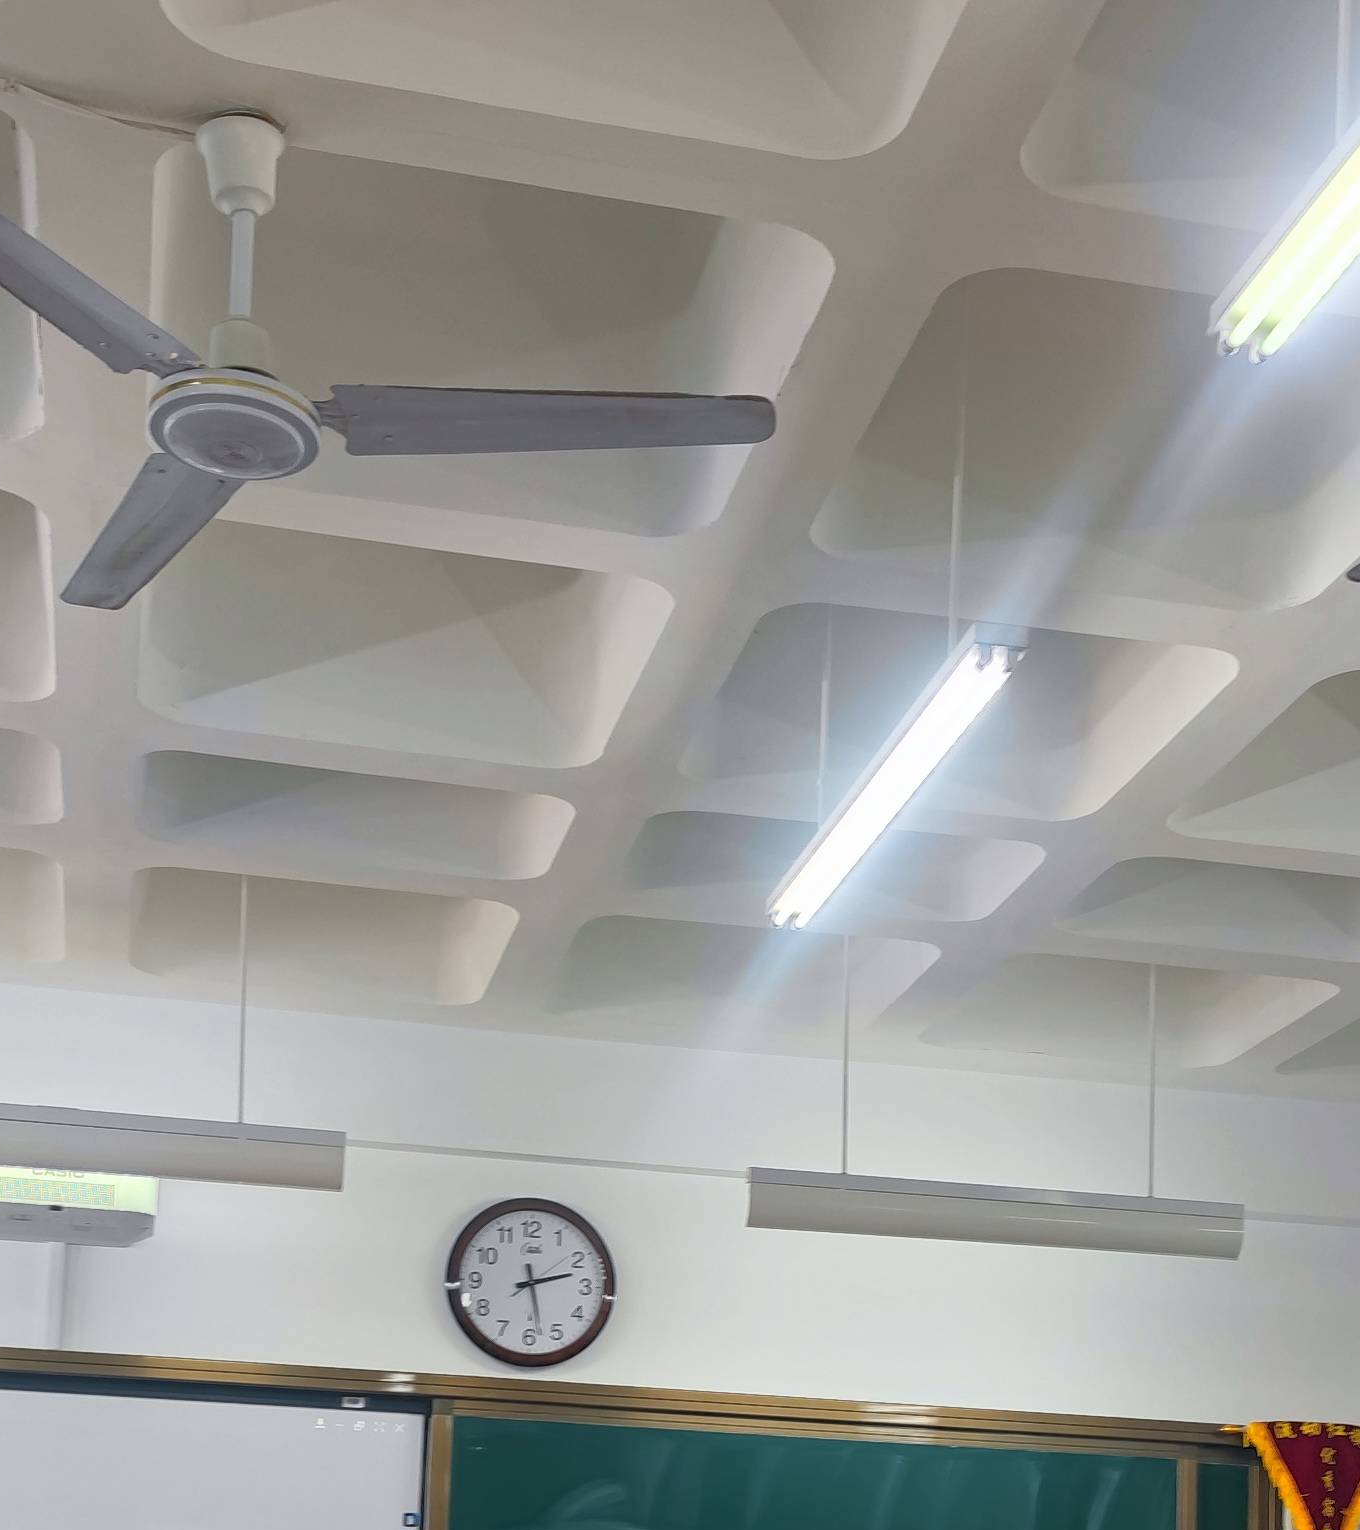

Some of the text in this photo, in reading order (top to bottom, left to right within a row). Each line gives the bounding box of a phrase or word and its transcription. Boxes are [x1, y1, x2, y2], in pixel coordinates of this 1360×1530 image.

[497, 1226, 513, 1244] 11
[520, 1220, 543, 1239] 12
[553, 1229, 562, 1246] 1
[476, 1246, 498, 1265] 10
[571, 1251, 585, 1269] 2
[468, 1271, 483, 1289] 9
[578, 1278, 593, 1296] 3
[475, 1298, 490, 1317] 8
[570, 1305, 584, 1321] 4
[497, 1319, 511, 1337] 7
[522, 1328, 536, 1346] 6
[549, 1323, 564, 1341] 5
